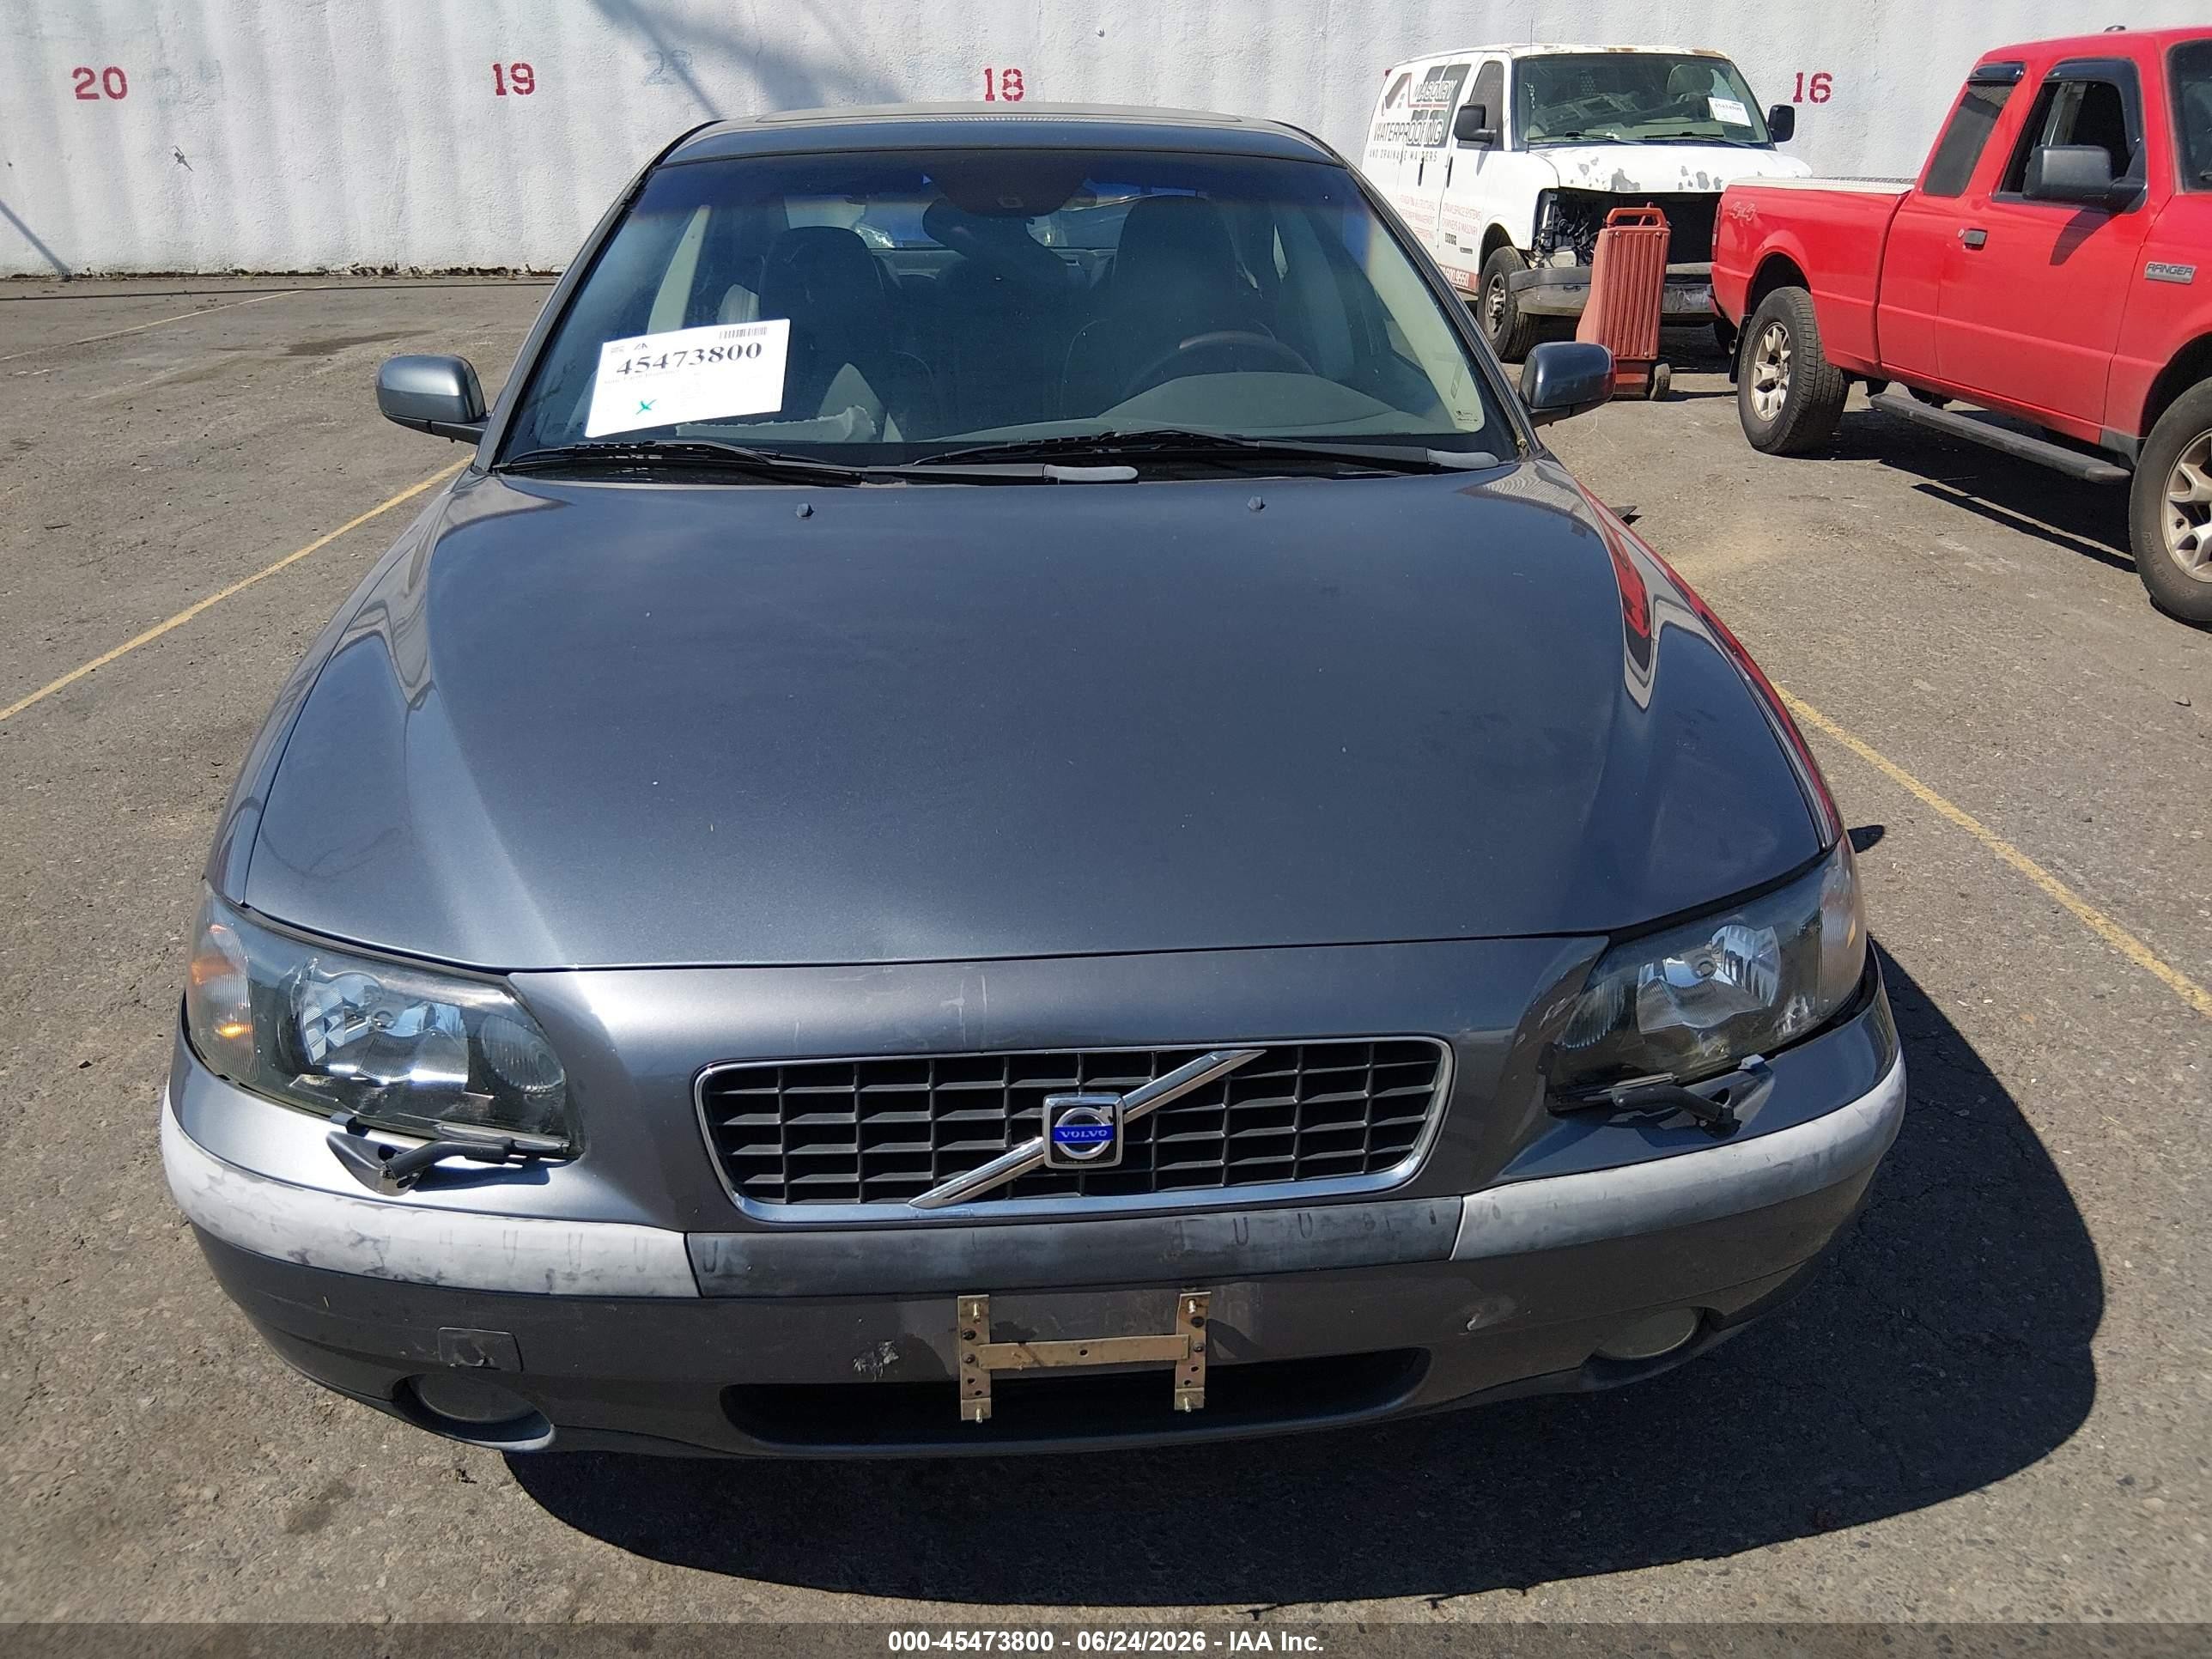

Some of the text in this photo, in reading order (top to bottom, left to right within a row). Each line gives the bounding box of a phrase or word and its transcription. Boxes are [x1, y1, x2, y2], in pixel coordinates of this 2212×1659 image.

[72, 66, 128, 100] 20
[493, 63, 535, 95] 19
[985, 68, 1024, 101] 18
[1793, 72, 1832, 103] 16
[1374, 120, 1443, 144] WATERPROOFING
[1380, 149, 1407, 161] DRAINAE
[2147, 263, 2193, 275] RANGER
[617, 343, 763, 375] 45473800
[1059, 1129, 1108, 1138] VOLVO
